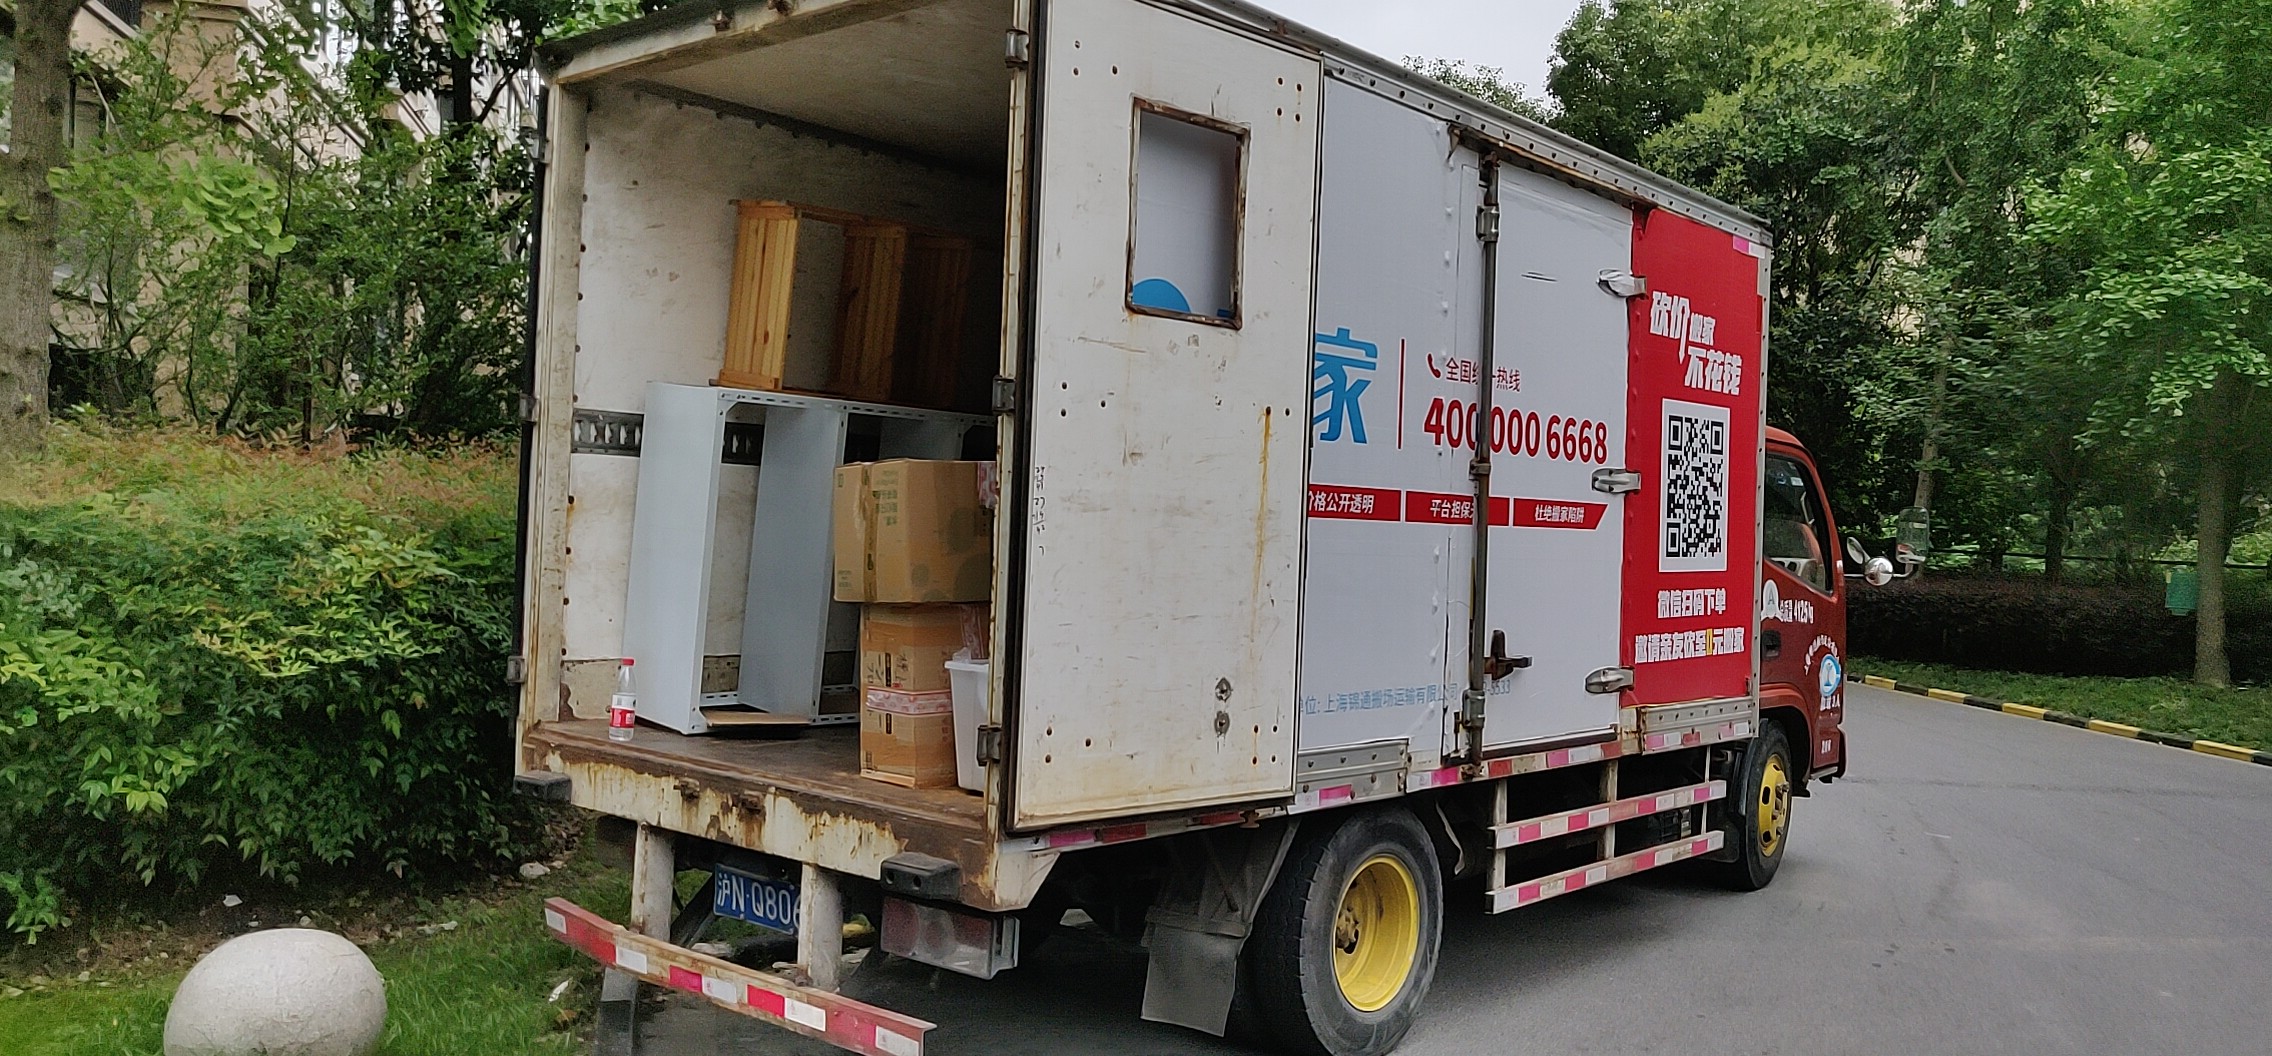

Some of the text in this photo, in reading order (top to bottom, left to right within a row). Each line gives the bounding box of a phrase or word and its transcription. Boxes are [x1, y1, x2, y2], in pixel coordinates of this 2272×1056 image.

[1650, 291, 1691, 364] 砍价
[1312, 327, 1378, 444] 家
[1684, 346, 1743, 396] 不花钱
[1547, 415, 1607, 465] 6668
[1535, 504, 1585, 524] 杜绝搬家陷阱
[1658, 588, 1727, 619] 微信扫码下单
[1635, 627, 1745, 664] 邀请亲友砍至0元搬家
